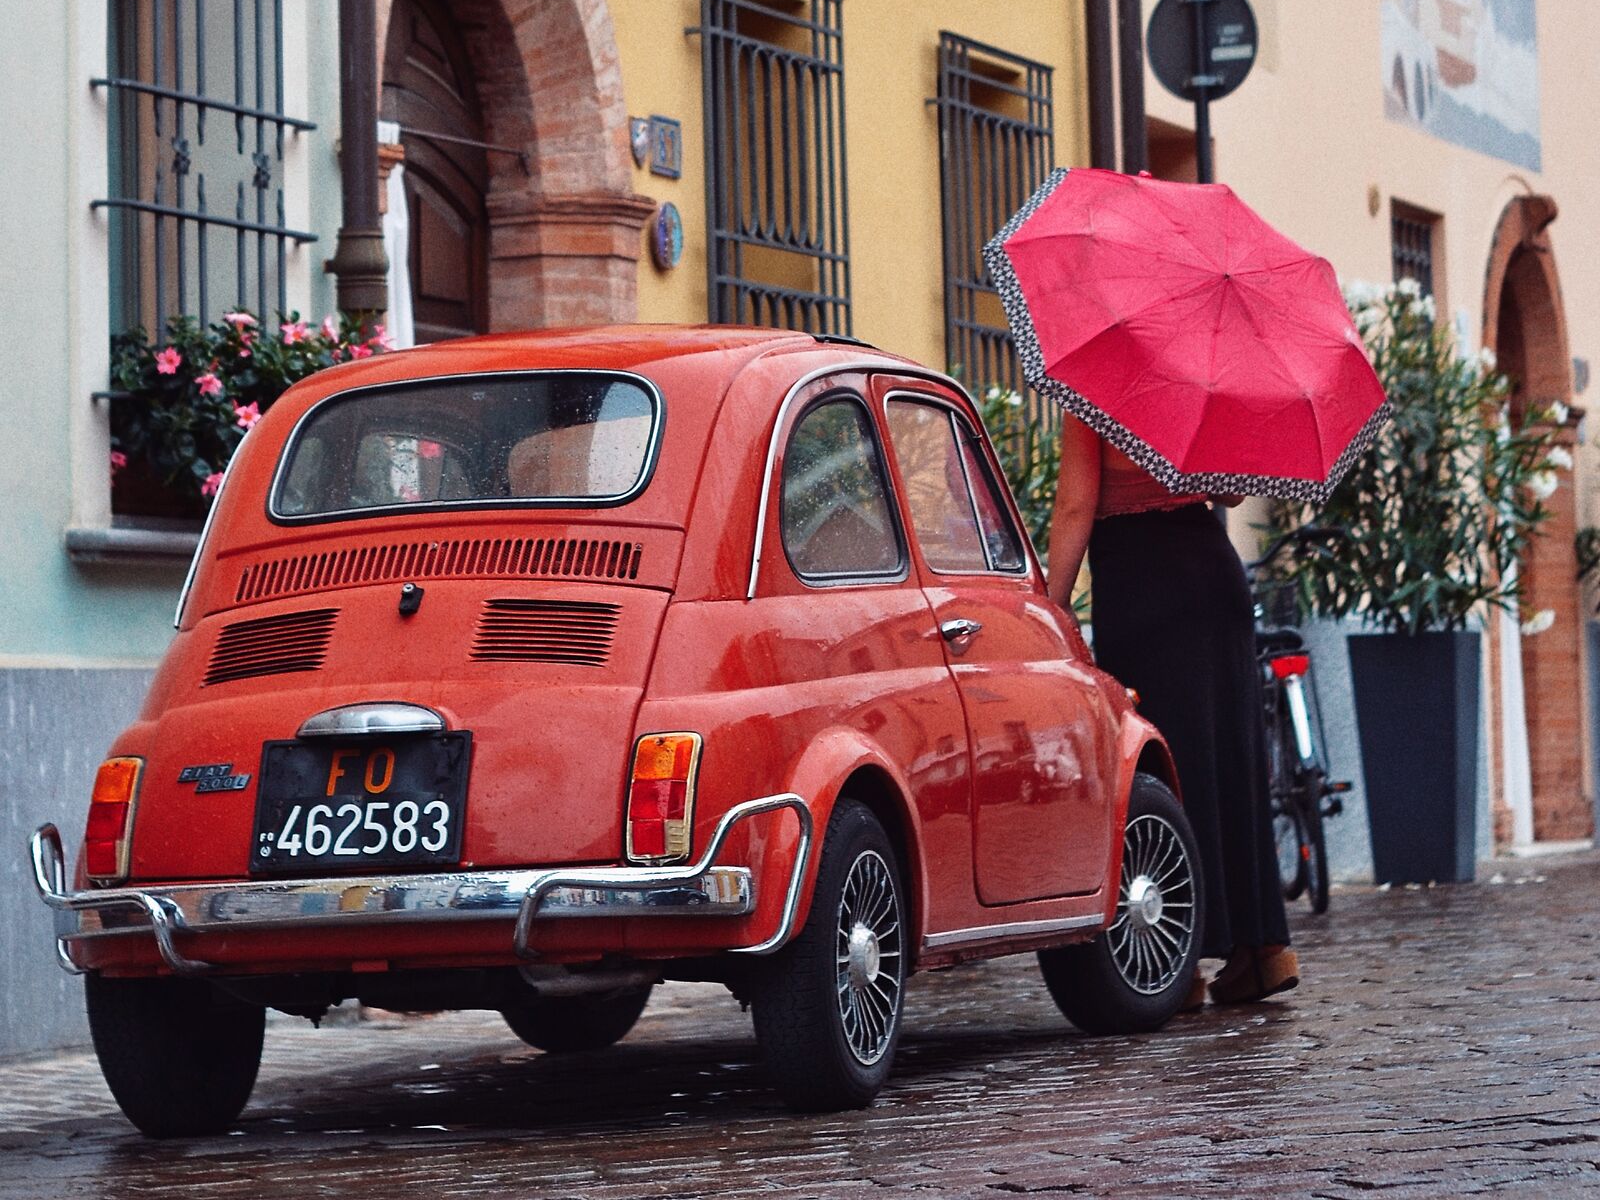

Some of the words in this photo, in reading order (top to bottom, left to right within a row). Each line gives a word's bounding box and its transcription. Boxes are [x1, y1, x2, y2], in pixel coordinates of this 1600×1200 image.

[182, 766, 230, 778] FIAT
[326, 749, 395, 797] FO
[200, 775, 248, 790] 500L
[277, 801, 449, 856] 462583
[260, 832, 274, 842] FO
